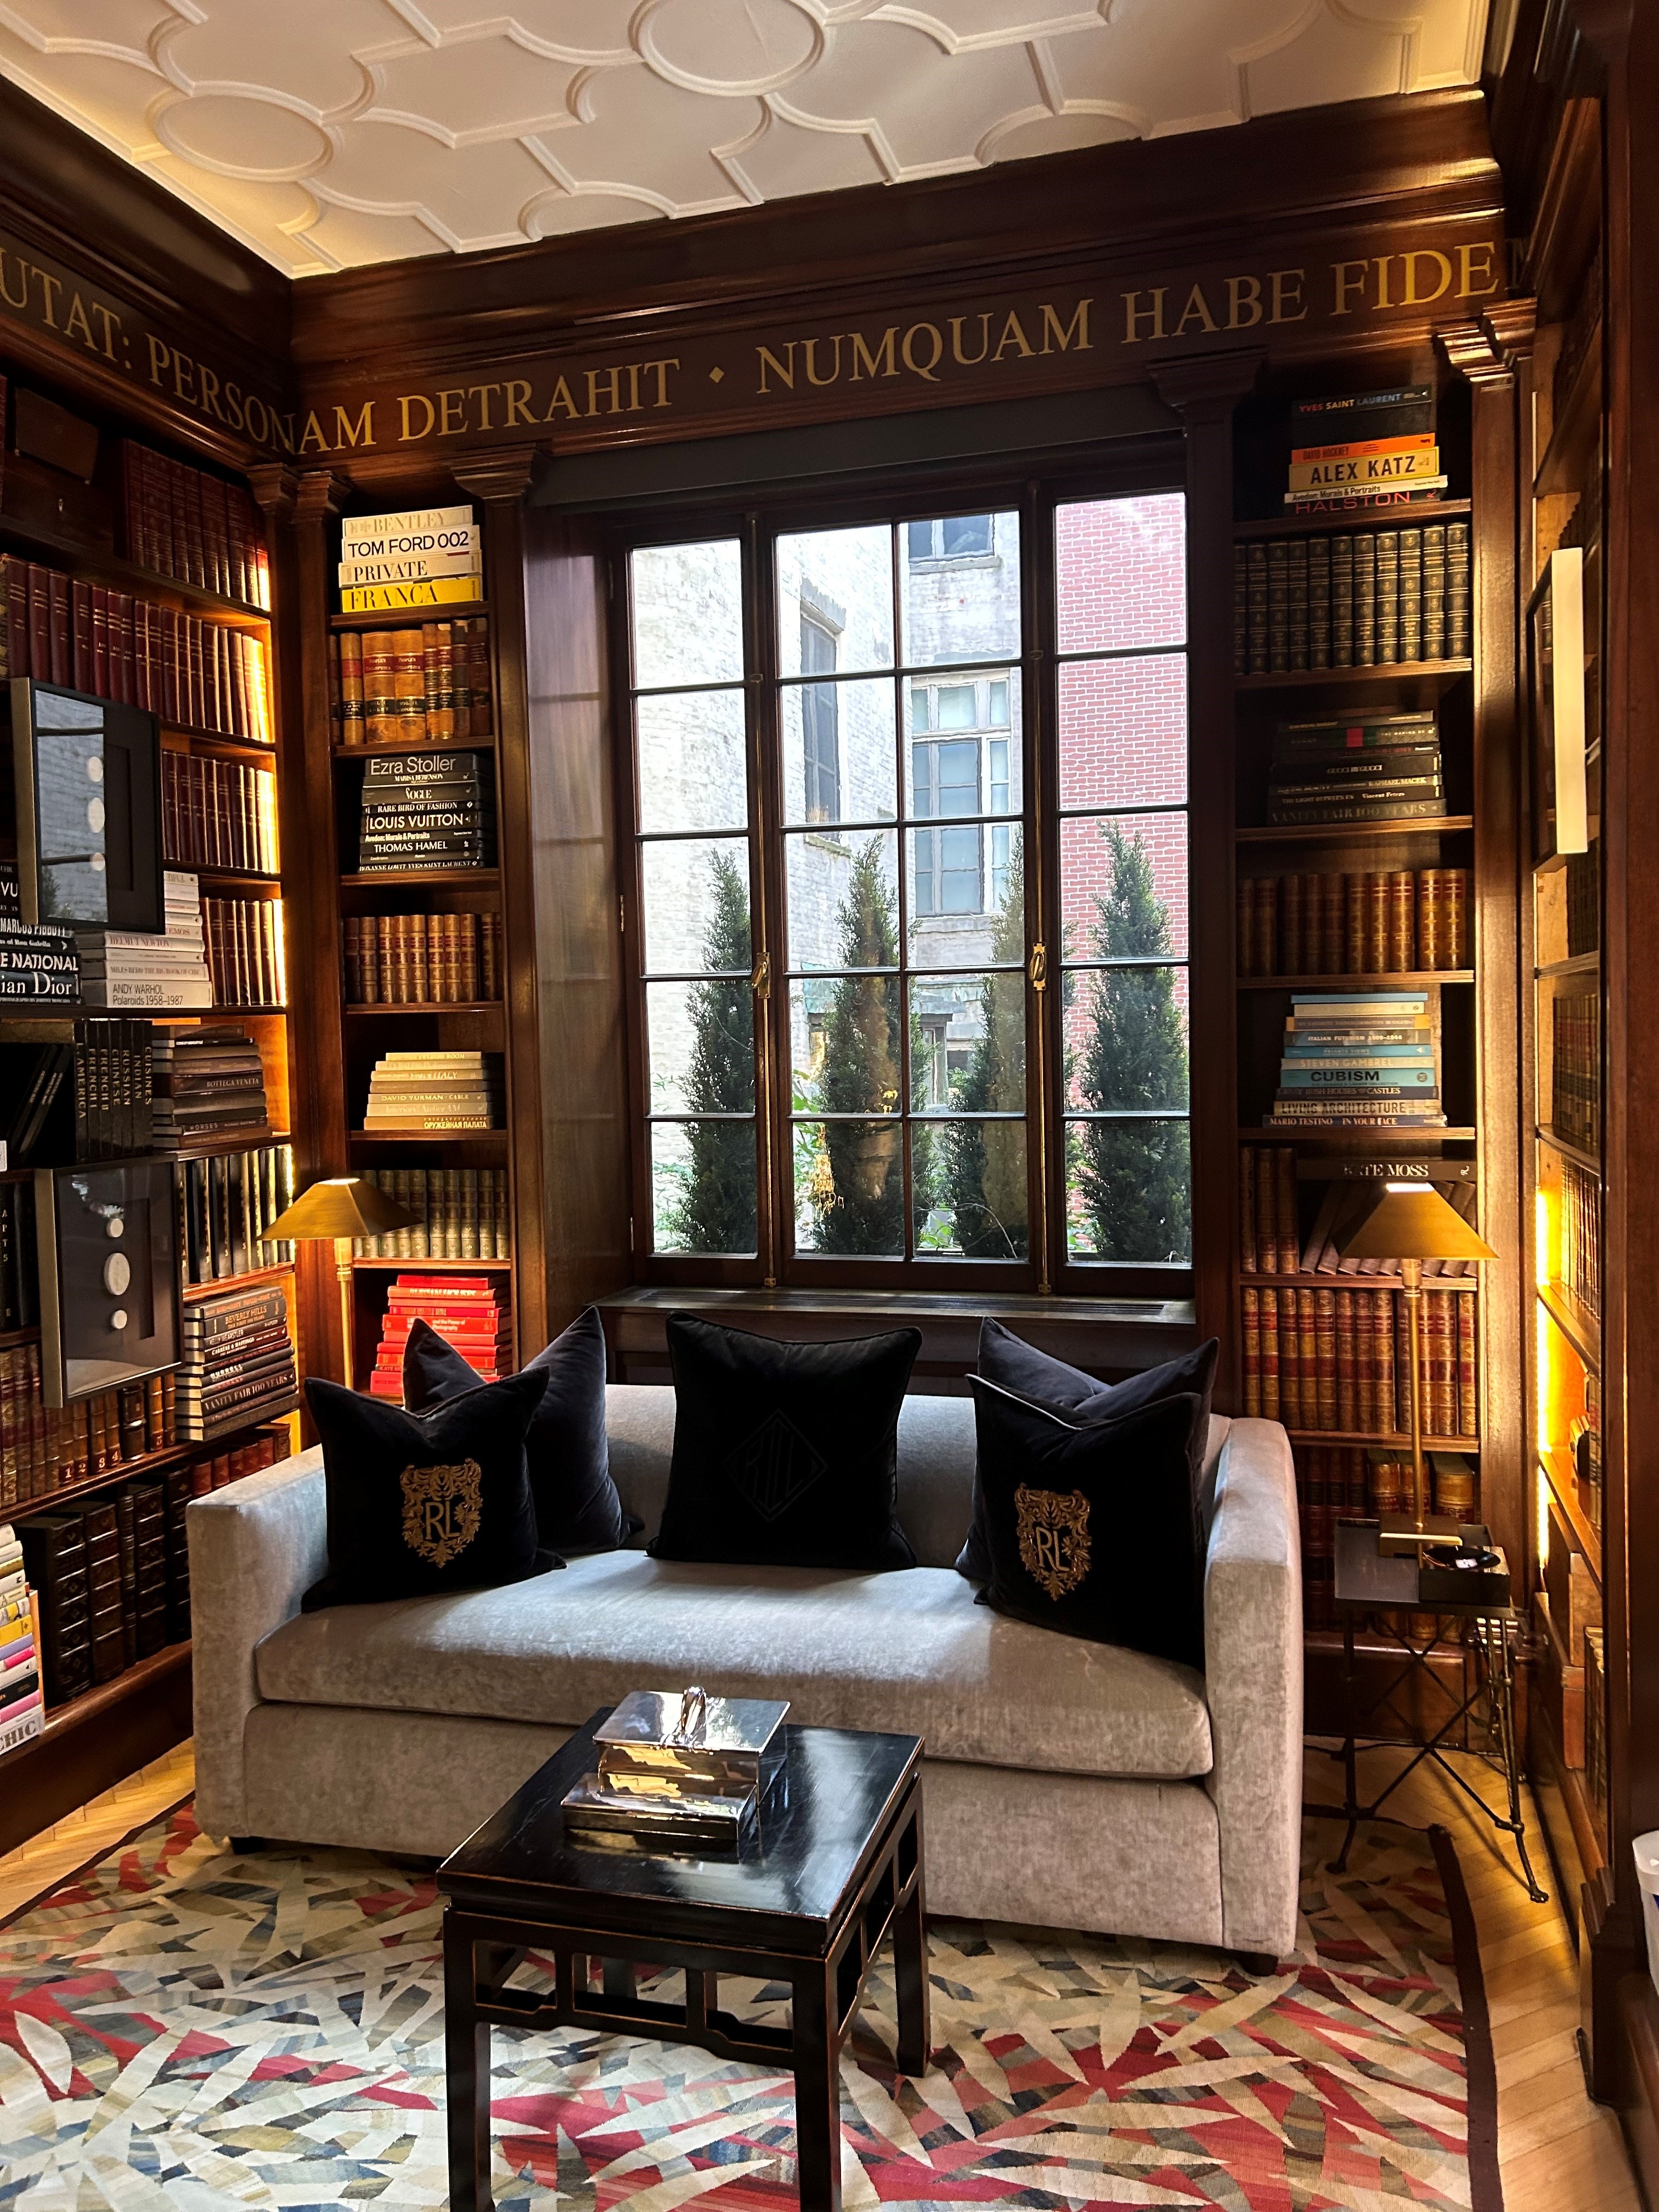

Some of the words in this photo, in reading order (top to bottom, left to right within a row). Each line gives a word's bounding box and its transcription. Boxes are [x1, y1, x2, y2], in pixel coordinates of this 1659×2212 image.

[144, 332, 377, 454] PERSONAM
[397, 358, 680, 441] DETRAHIT
[755, 298, 1094, 393] NUMQUAM
[1120, 268, 1308, 344] HABE
[1299, 403, 1324, 413] YVES
[1325, 399, 1356, 410] SAINT
[1310, 462, 1358, 484] ALEX
[1368, 455, 1416, 478] KATZ
[1350, 485, 1381, 494] Portraits
[1294, 492, 1411, 514] HALSTON
[374, 511, 446, 532] BENTLEY
[348, 540, 384, 558] TOM
[388, 535, 435, 554] FORD
[437, 531, 469, 548] 002
[354, 560, 428, 582] PRIVATE
[351, 584, 439, 610] FRANCA
[370, 759, 403, 775] Ezra
[407, 755, 456, 773] Stoller
[377, 805, 397, 813] RARE
[427, 802, 458, 810] FASHION
[370, 816, 405, 830] LOUIS
[408, 814, 463, 827] VUITTON
[374, 843, 413, 853] THOMAS
[416, 841, 448, 850] HAMEL
[12, 952, 79, 971] NATIONAL
[31, 970, 72, 995] Dior
[113, 984, 133, 994] ANDY
[134, 984, 165, 995] WARHOL
[113, 995, 145, 1006] Polaroids
[1300, 1059, 1339, 1068] STEVEN
[1341, 1059, 1393, 1067] GAMBREL
[88, 1048, 97, 1101] FRENCH
[100, 1048, 109, 1101] FRENCH
[112, 1049, 121, 1106] CHINESE
[122, 1049, 131, 1105] RUSSIAN
[133, 1055, 142, 1099] INDIAN
[207, 1079, 234, 1088] BOTTEGA
[1311, 1071, 1380, 1082] CUBISM
[77, 1058, 86, 1119] AMERICA
[1281, 1102, 1317, 1114] LIVING
[1322, 1102, 1406, 1114] ARCHITECTURE
[424, 1121, 462, 1129] ОРУЖЕЙНАЯ
[1387, 1164, 1429, 1177] MOSS
[225, 1310, 250, 1325] BEVERLY
[251, 1305, 268, 1317] HILLS
[112, 1451, 119, 1461] 4
[65, 1468, 72, 1479] 1
[78, 1463, 86, 1473] 2
[425, 1500, 460, 1540] RL
[1036, 1526, 1070, 1572] RL
